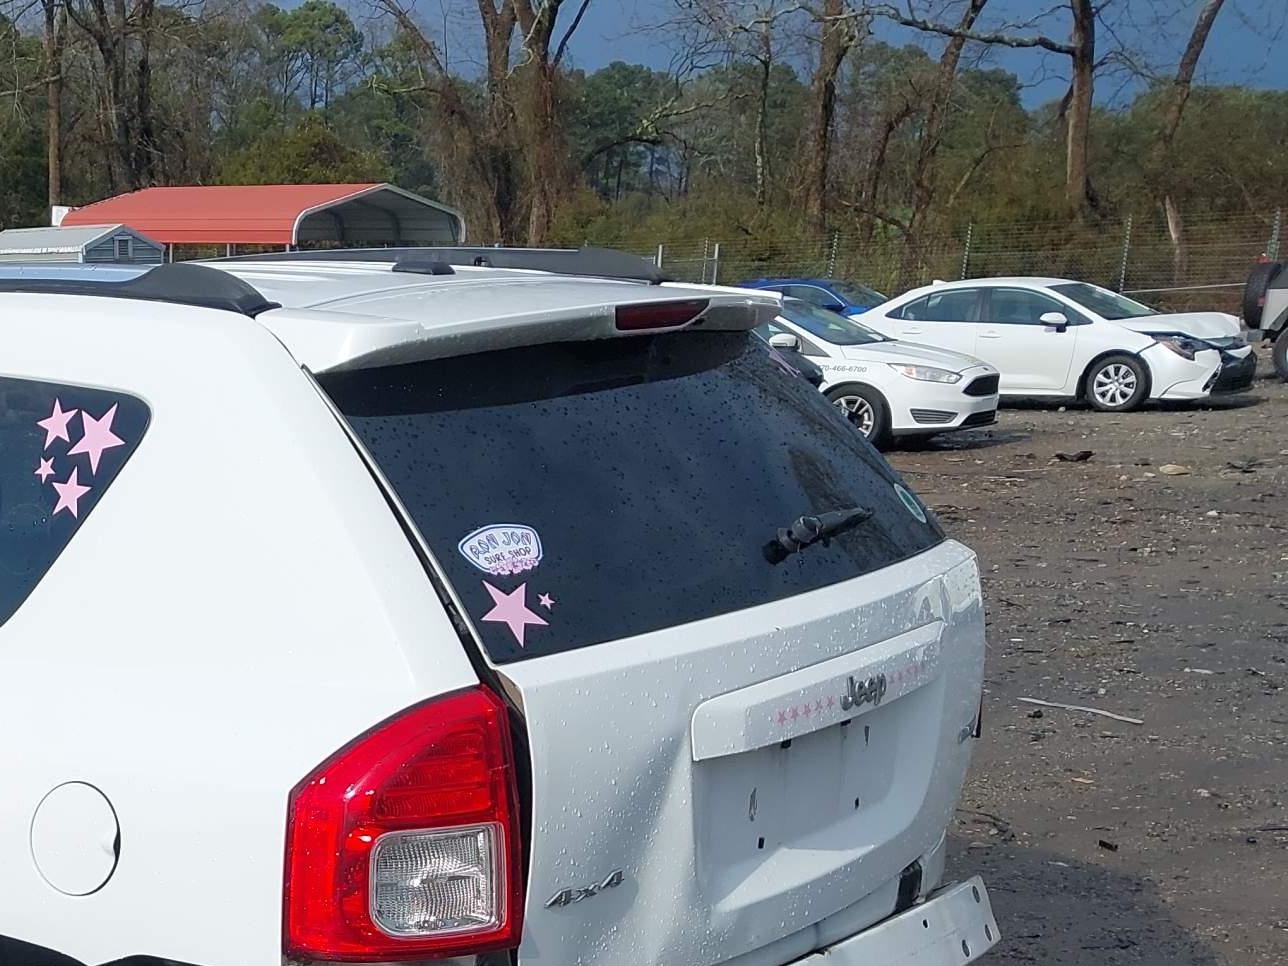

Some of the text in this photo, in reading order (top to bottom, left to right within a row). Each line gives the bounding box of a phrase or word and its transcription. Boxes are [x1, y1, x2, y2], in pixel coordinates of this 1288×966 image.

[484, 546, 531, 565] SURF SHOP
[839, 673, 887, 711] Jeep
